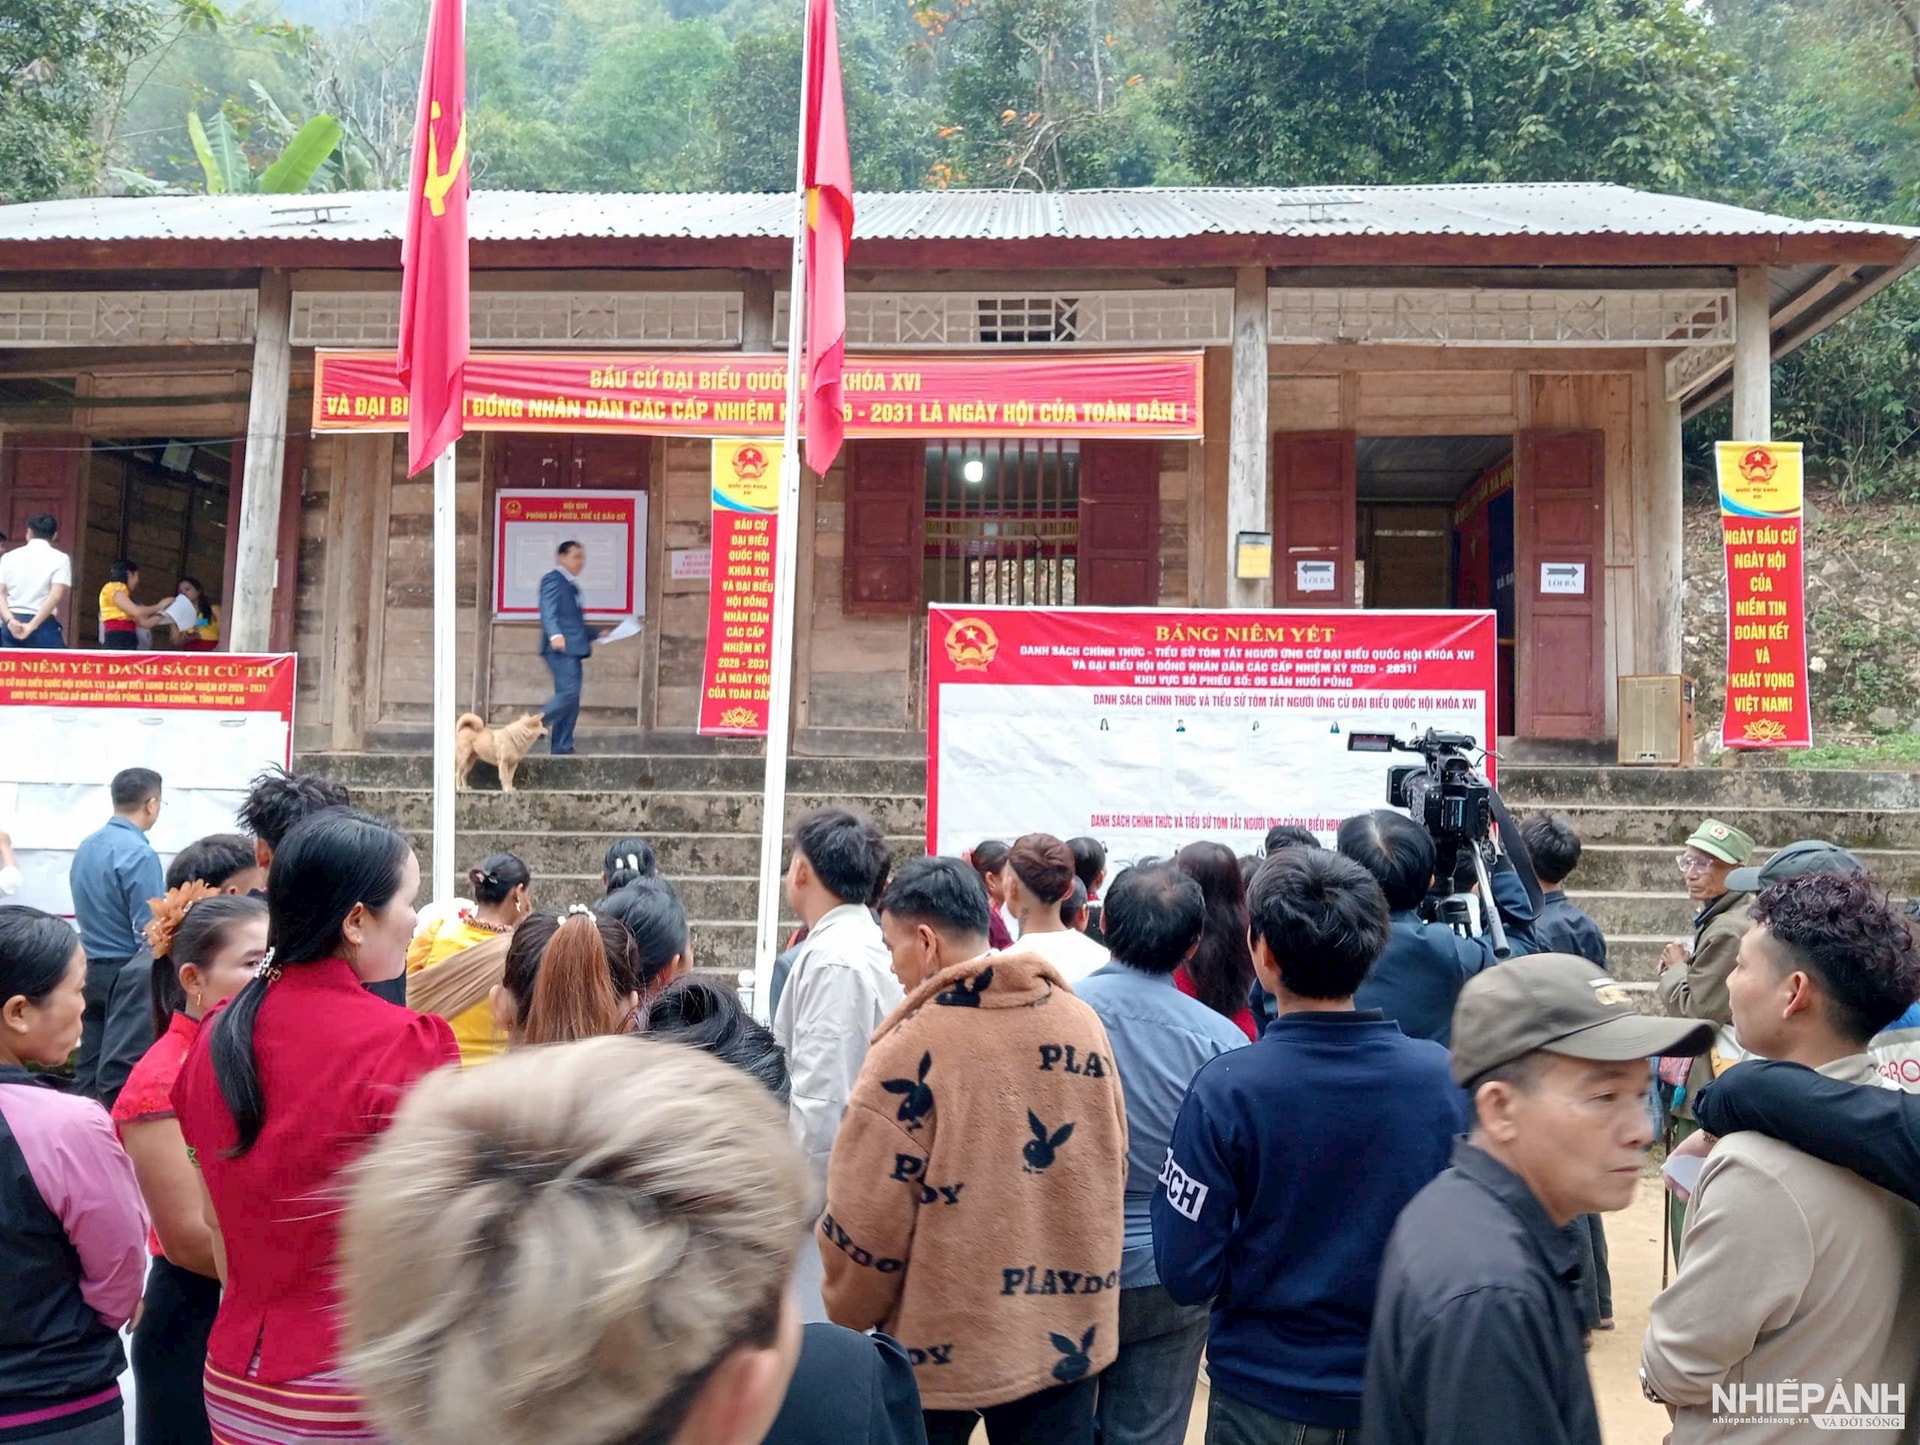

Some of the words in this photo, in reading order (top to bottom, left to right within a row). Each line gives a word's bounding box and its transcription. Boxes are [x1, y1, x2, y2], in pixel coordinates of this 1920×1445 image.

[632, 366, 659, 389] CỬ
[662, 371, 693, 393] ĐẠI
[699, 366, 740, 390] BIỂU
[891, 373, 921, 391] XVI
[327, 396, 350, 416] VÀ
[355, 397, 385, 420] ĐẠI
[528, 397, 580, 419] NHÂN
[585, 397, 625, 419] DÂN
[629, 397, 666, 420] CÁC
[671, 395, 708, 421] CẤP
[713, 398, 775, 426] NHIỆM
[870, 402, 914, 423] 2031
[920, 399, 943, 422] LÀ
[948, 399, 997, 423] NGÀY
[1003, 399, 1034, 427] HỘI
[1038, 398, 1076, 423] CỦA
[1082, 397, 1131, 422] TOÀN
[1136, 398, 1175, 422] DÂN
[1768, 601, 1787, 616] TIN
[1156, 622, 1219, 642] BẢNG
[1225, 622, 1284, 643] NIÊM
[1290, 623, 1336, 643] YẾT
[1039, 1044, 1113, 1078] PLA
